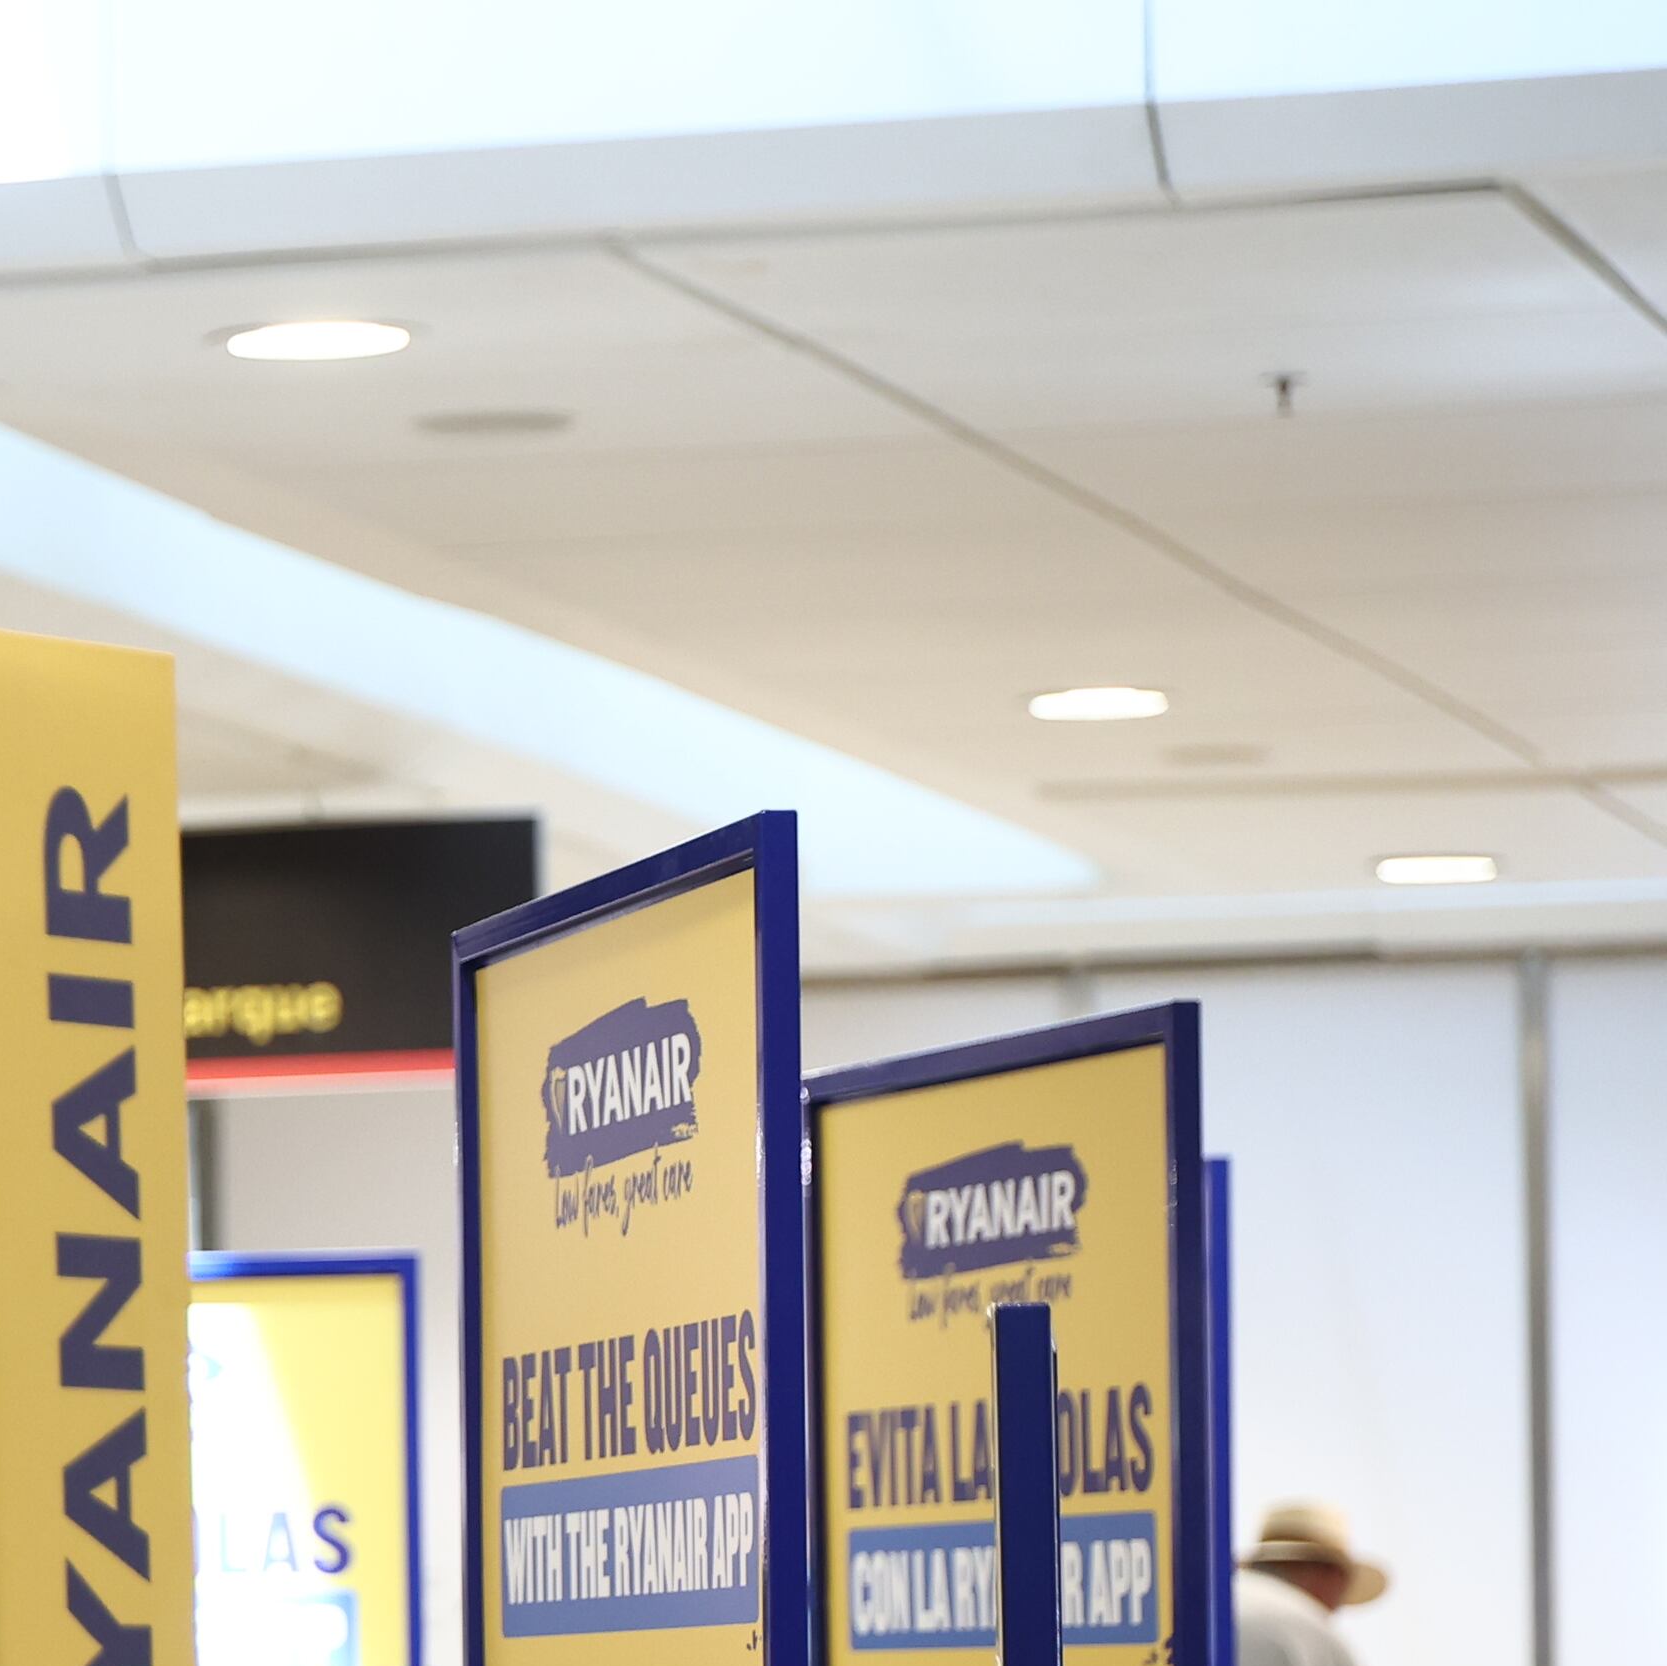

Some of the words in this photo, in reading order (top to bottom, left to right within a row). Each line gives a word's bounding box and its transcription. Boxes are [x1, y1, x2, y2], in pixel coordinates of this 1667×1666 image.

[568, 1033, 691, 1136] RYANAIR
[925, 1170, 1076, 1249] RYANAIR
[503, 1346, 571, 1471] BEAT
[578, 1335, 636, 1460] THE
[644, 1309, 756, 1455] QUEUES
[848, 1403, 941, 1509] EVITA
[195, 1505, 351, 1575] LAS
[504, 1514, 563, 1605] WITH
[566, 1508, 610, 1600] THE
[614, 1496, 709, 1597] RYANAIR
[712, 1492, 754, 1589] APP
[852, 1549, 912, 1636] CON
[913, 1548, 953, 1633] LA
[1088, 1537, 1152, 1627] APP
